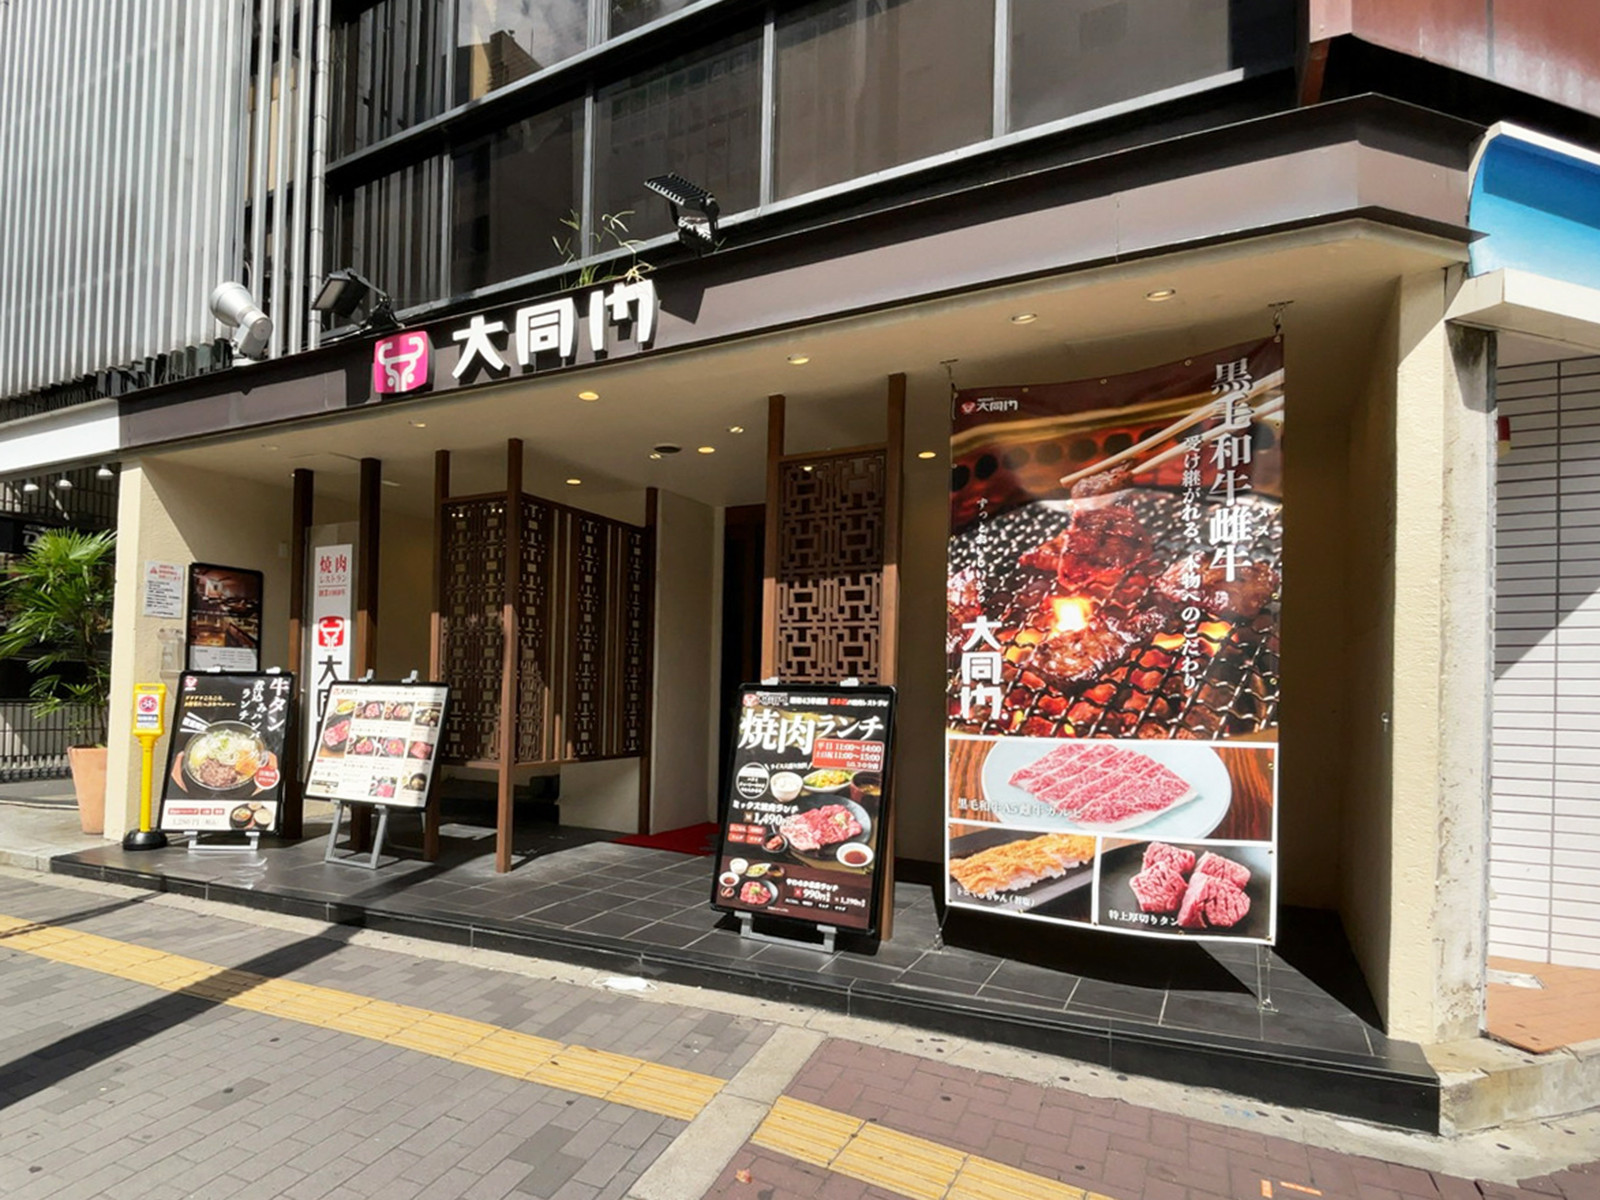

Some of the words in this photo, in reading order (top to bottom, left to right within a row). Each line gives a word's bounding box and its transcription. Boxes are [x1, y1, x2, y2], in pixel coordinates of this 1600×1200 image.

[452, 280, 656, 379] 大同門
[1210, 357, 1255, 583] 黒毛和牛雌牛
[319, 575, 346, 584] レストラン
[320, 554, 347, 573] 焼肉
[961, 615, 1002, 720] 大同門
[239, 688, 251, 721] ランチ
[267, 677, 290, 732] 牛タン
[738, 708, 884, 755] 焼肉ランチ
[1108, 909, 1179, 926] 特上厚切りタン
